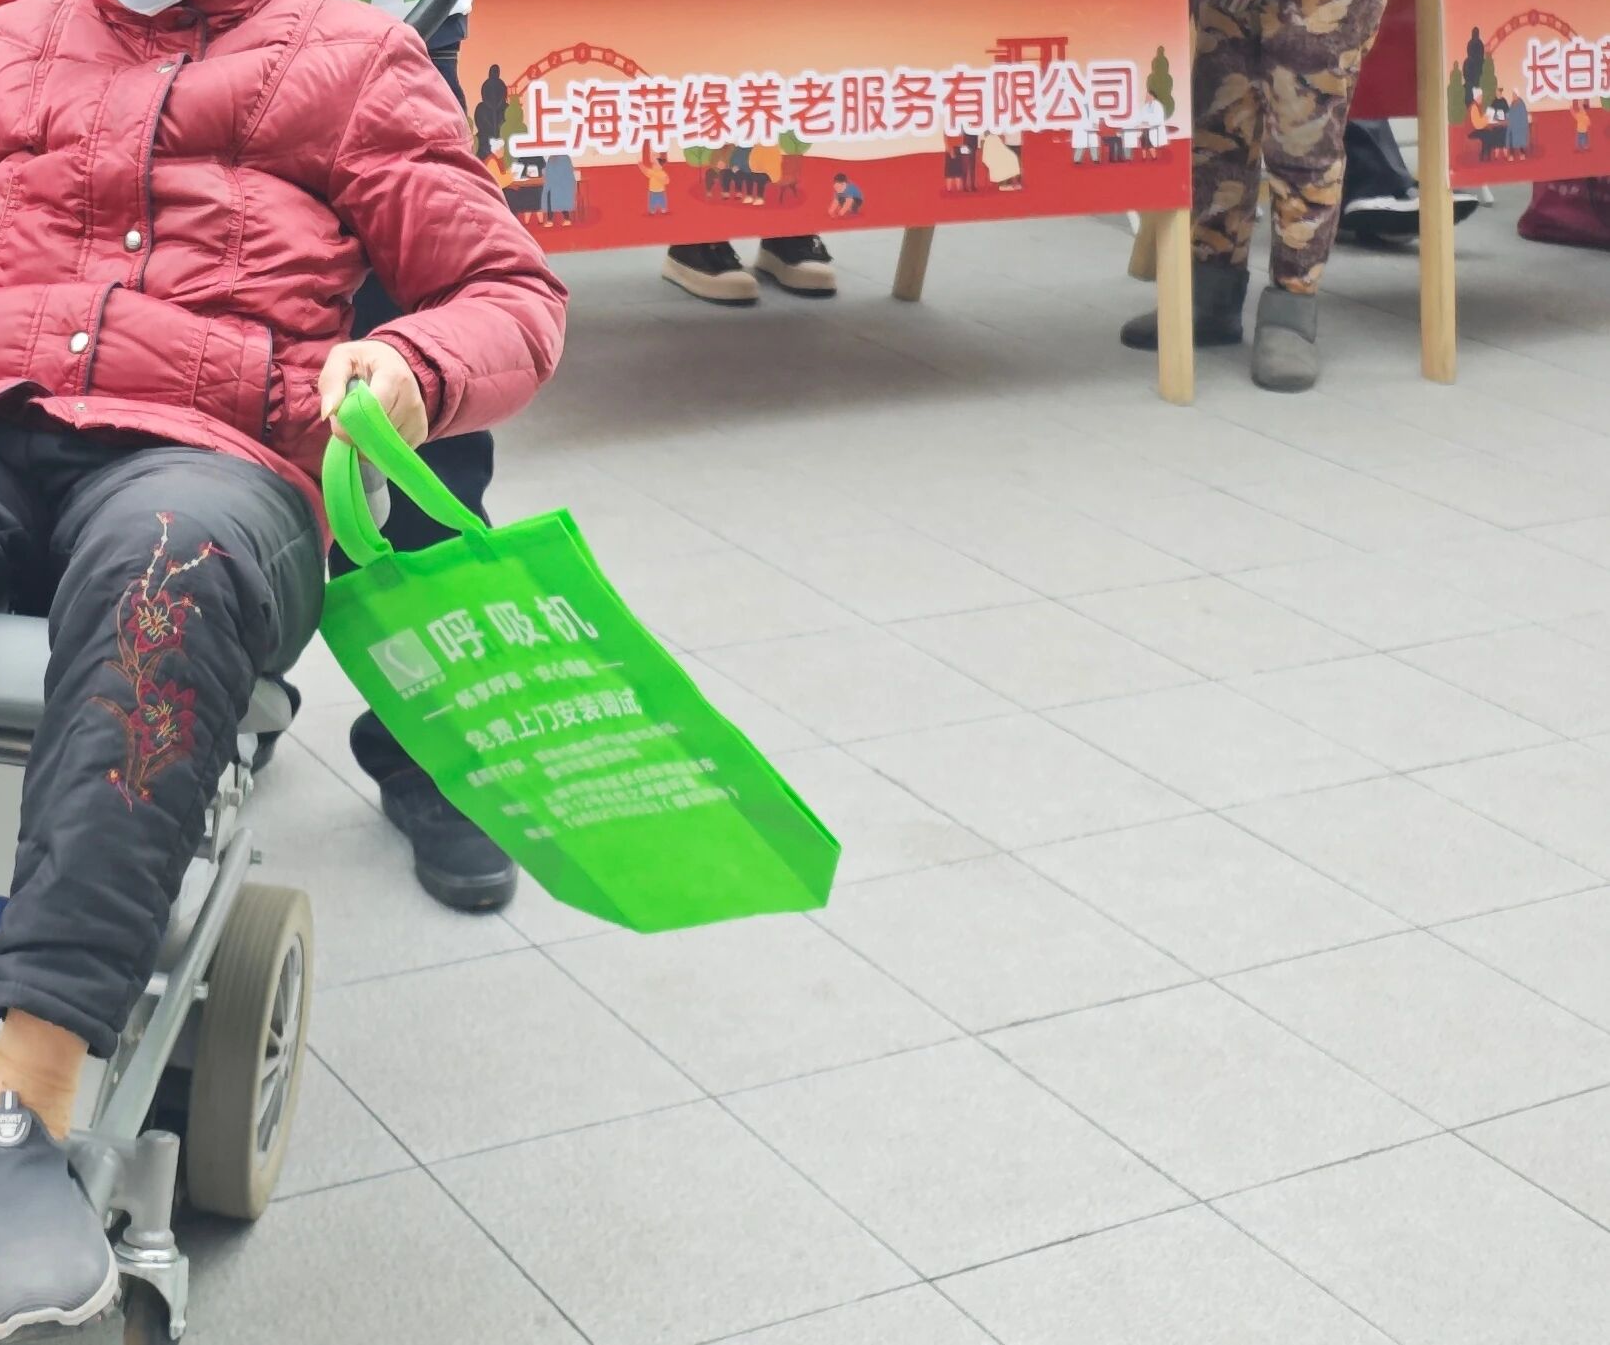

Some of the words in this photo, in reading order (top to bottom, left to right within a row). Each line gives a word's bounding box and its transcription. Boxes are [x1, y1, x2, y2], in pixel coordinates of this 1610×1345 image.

[514, 64, 1138, 152] 上海萍缘养老服务有限公司
[426, 596, 599, 663] 呼吸机
